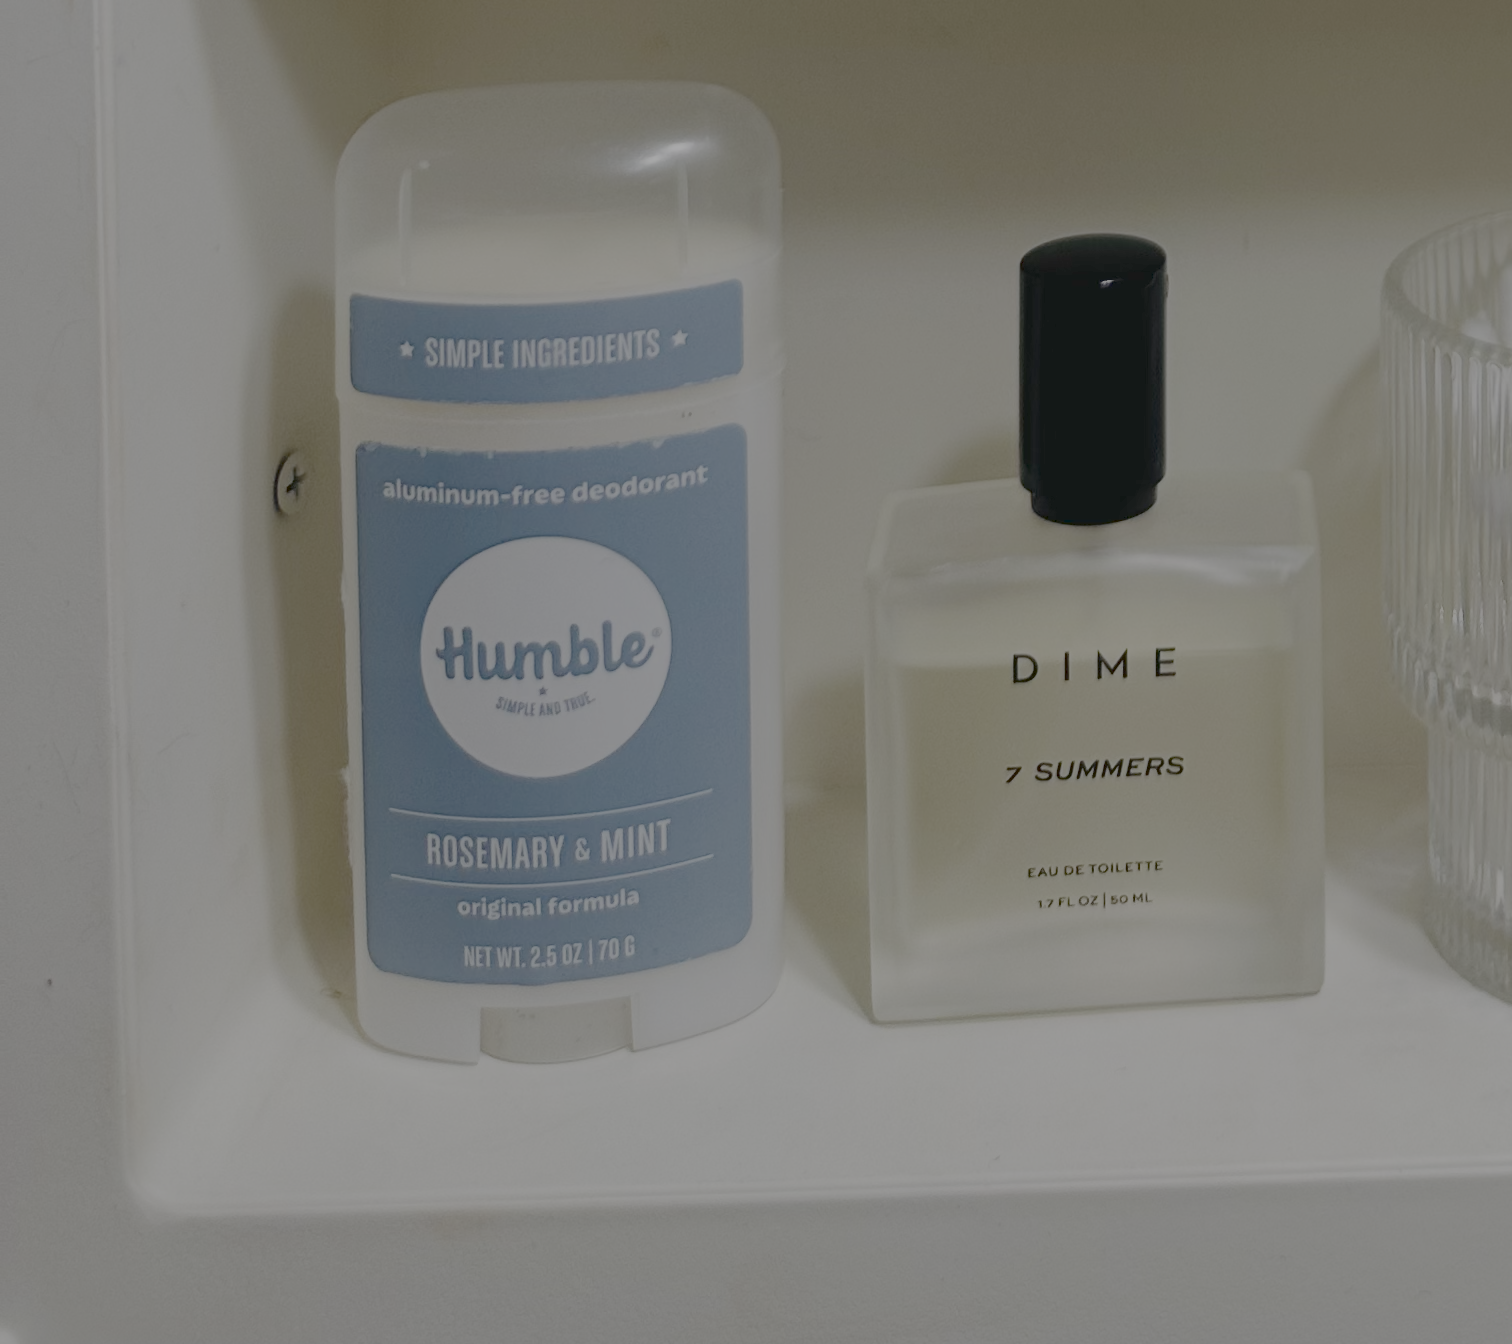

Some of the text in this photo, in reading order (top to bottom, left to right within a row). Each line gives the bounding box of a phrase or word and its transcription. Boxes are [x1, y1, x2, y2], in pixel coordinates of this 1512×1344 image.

[424, 328, 661, 369] SIMPLE INGREDIENTS
[382, 464, 709, 506] aluminum-free deodorant
[436, 619, 655, 680] Humble
[1012, 647, 1176, 683] DIME
[496, 696, 537, 716] SIMPLE
[539, 701, 562, 716] AND
[1006, 756, 1184, 783] 7 SUMMERS
[426, 818, 671, 870] ROSEMARY & MINT
[1028, 860, 1163, 878] EAU DE TOILETTE
[457, 888, 640, 921] original formula
[1058, 897, 1075, 907] FL
[1078, 895, 1099, 907] OZ
[1110, 894, 1129, 905] 50
[1133, 893, 1153, 903] ML
[463, 946, 493, 969] NET
[495, 946, 525, 969] WT.
[530, 945, 557, 968] 2.5
[561, 942, 583, 966] OZ
[598, 937, 620, 961] 70
[624, 935, 636, 957] G
